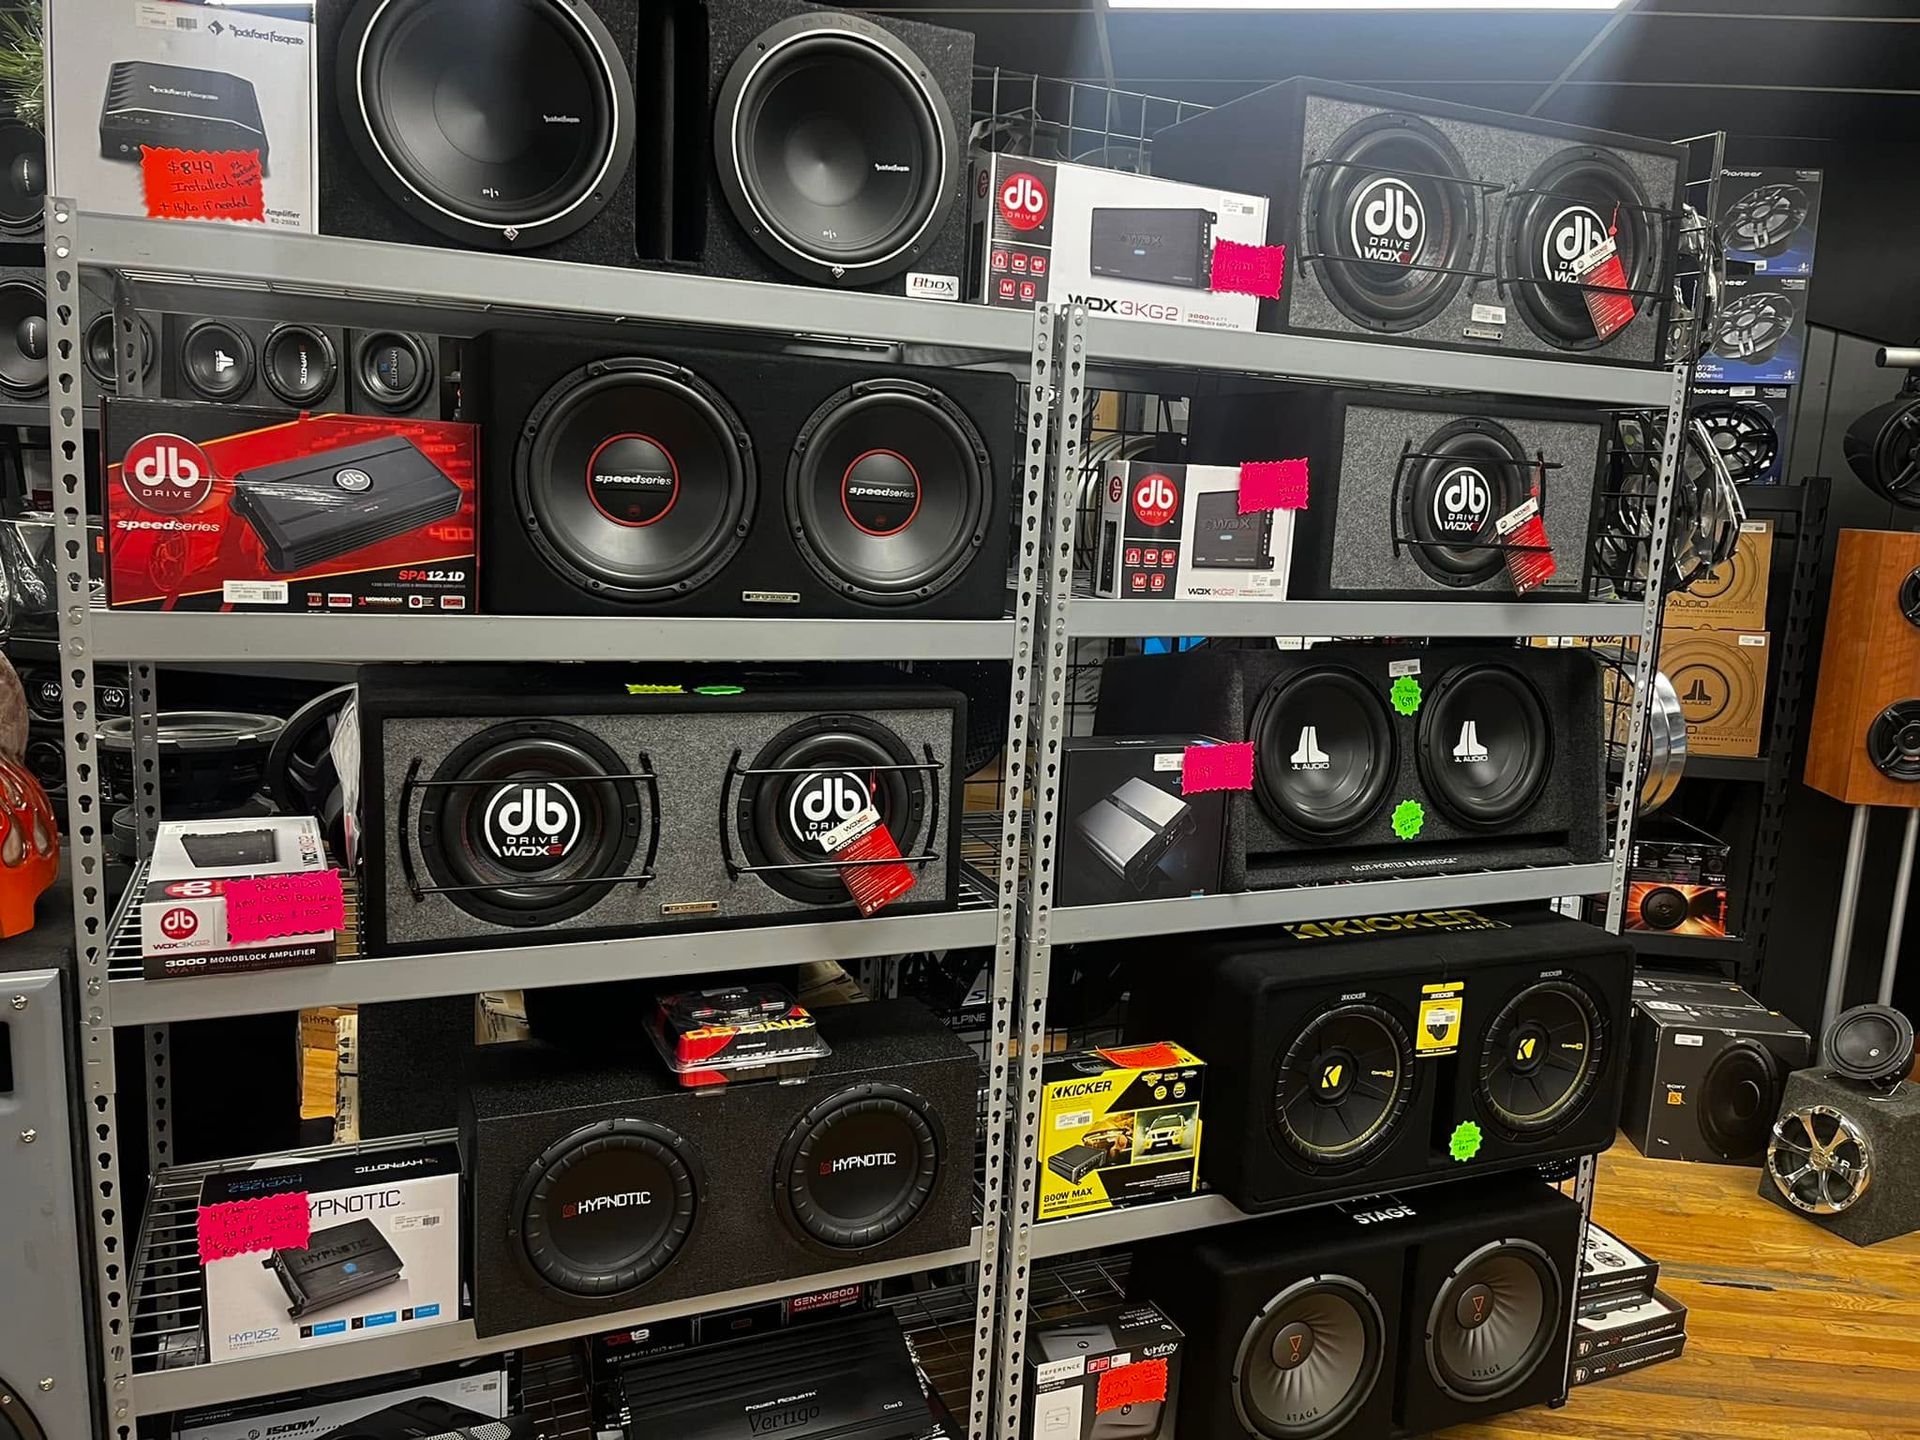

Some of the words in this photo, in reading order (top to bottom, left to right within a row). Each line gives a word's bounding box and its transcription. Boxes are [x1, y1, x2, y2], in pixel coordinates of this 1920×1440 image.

[1720, 169, 1762, 178] Pioneer
[1003, 178, 1042, 210] db
[266, 208, 301, 219] Amplifier
[1007, 211, 1038, 222] DRIVE
[1364, 188, 1419, 240] db
[1369, 236, 1411, 250] DRIVE
[135, 446, 200, 488] db
[594, 474, 672, 487] speedseries
[142, 489, 192, 499] DRIVE
[849, 485, 915, 499] speedseries
[1137, 479, 1174, 509] db
[1444, 475, 1486, 514] db
[1140, 509, 1168, 518] DRIVE
[1448, 512, 1481, 521] DRIVE
[116, 519, 220, 534] speedseries
[398, 570, 466, 583] SPA12.1D
[1291, 762, 1302, 771] JL
[1302, 761, 1330, 770] AUDIO
[1454, 755, 1463, 763] JL
[1463, 754, 1489, 762] AUDIO
[802, 778, 862, 821] db
[499, 788, 567, 834] db
[506, 836, 559, 845] DRIVE
[163, 911, 195, 930] db
[1319, 909, 1490, 937] KICKER
[164, 957, 207, 968] 3000
[209, 953, 267, 964] MONOBLOCK
[268, 948, 316, 959] AMPLIFIER
[1062, 1080, 1112, 1098] KICKER
[355, 1158, 423, 1173] HYPNOTIC
[832, 1152, 897, 1173] HYPNOTIC
[1043, 1191, 1070, 1203] 800W
[1071, 1187, 1093, 1197] MAX
[577, 1191, 651, 1215] HYPNOTIC
[1353, 1205, 1417, 1225] STAGE
[228, 1328, 279, 1343] HYP1252
[1039, 1363, 1081, 1376] REFERENCE
[1472, 1363, 1501, 1378] STAGE
[748, 1403, 821, 1433] Vertigo
[1286, 1406, 1319, 1422] STAGE
[266, 1416, 320, 1437] 1500W
